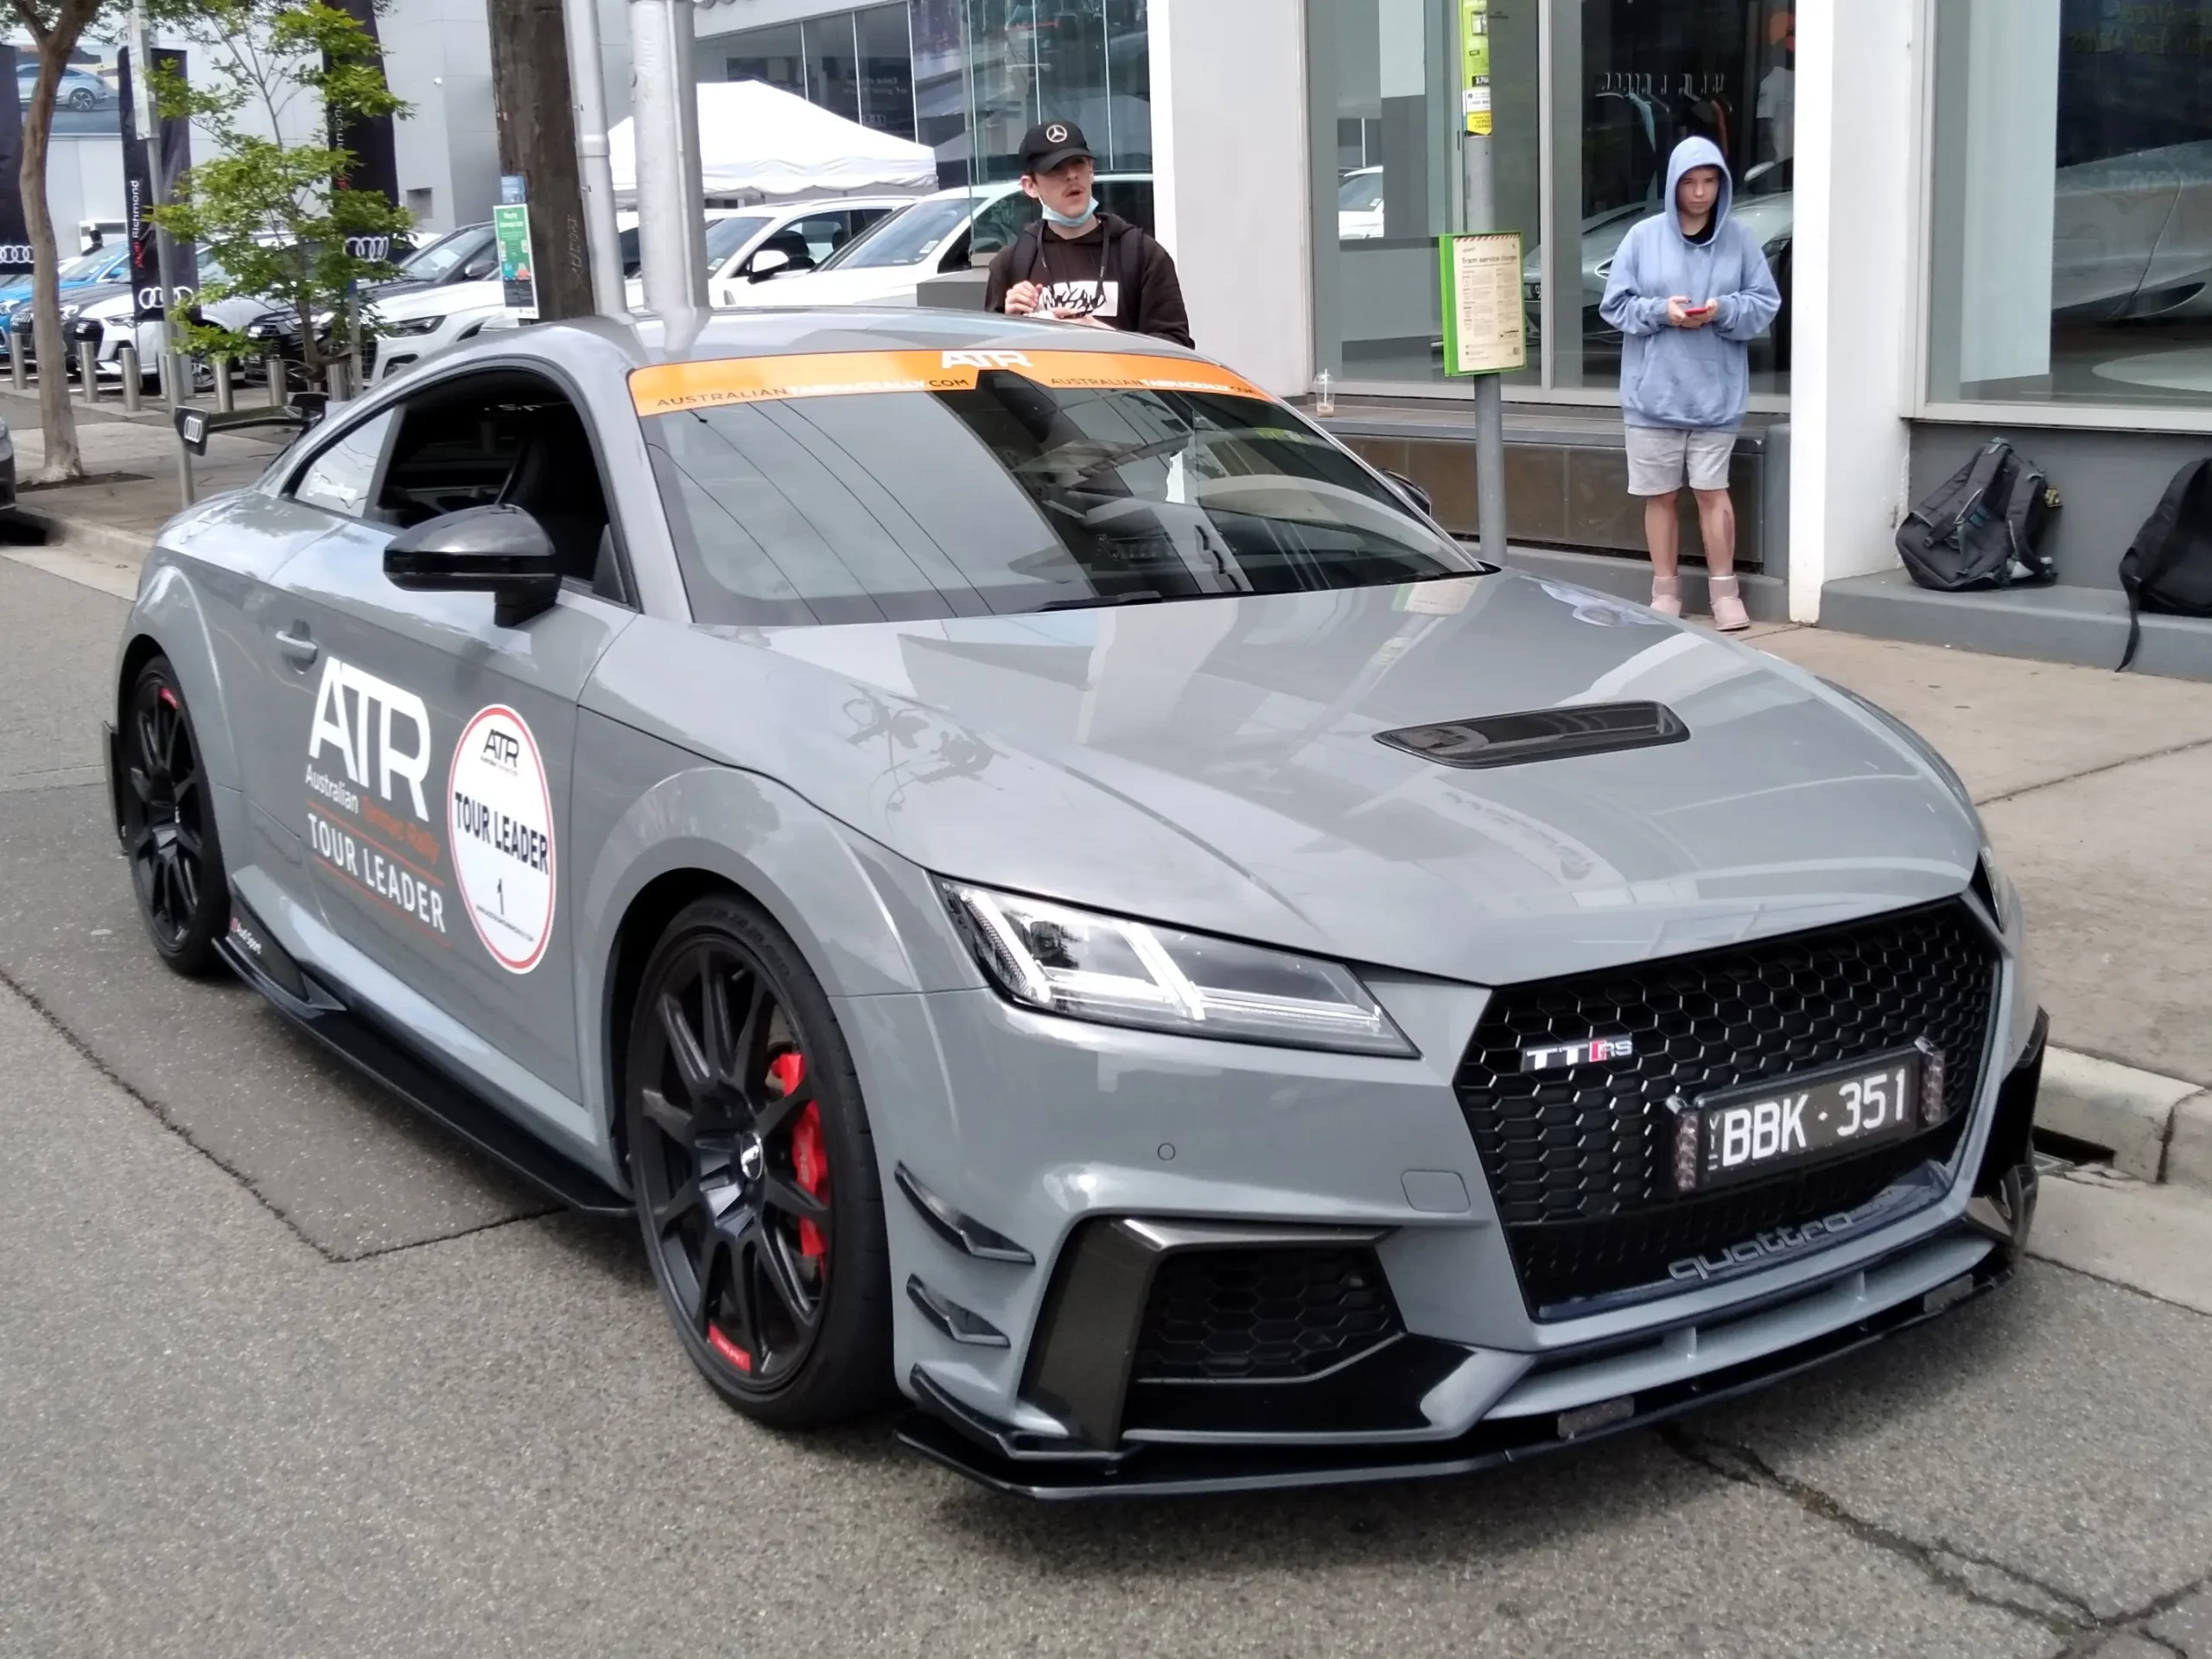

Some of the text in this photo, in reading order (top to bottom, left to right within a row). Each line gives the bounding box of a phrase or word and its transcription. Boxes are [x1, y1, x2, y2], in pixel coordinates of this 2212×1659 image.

[130, 180, 140, 238] Richmond
[942, 350, 1033, 369] ATR
[308, 656, 430, 823] ATR
[482, 728, 520, 768] ATR
[305, 764, 359, 814] Australian
[454, 791, 549, 875] TOUR LEADER
[308, 812, 358, 876] TOUR
[363, 848, 446, 933] LEADER
[1668, 1212, 1853, 1280] quattro
